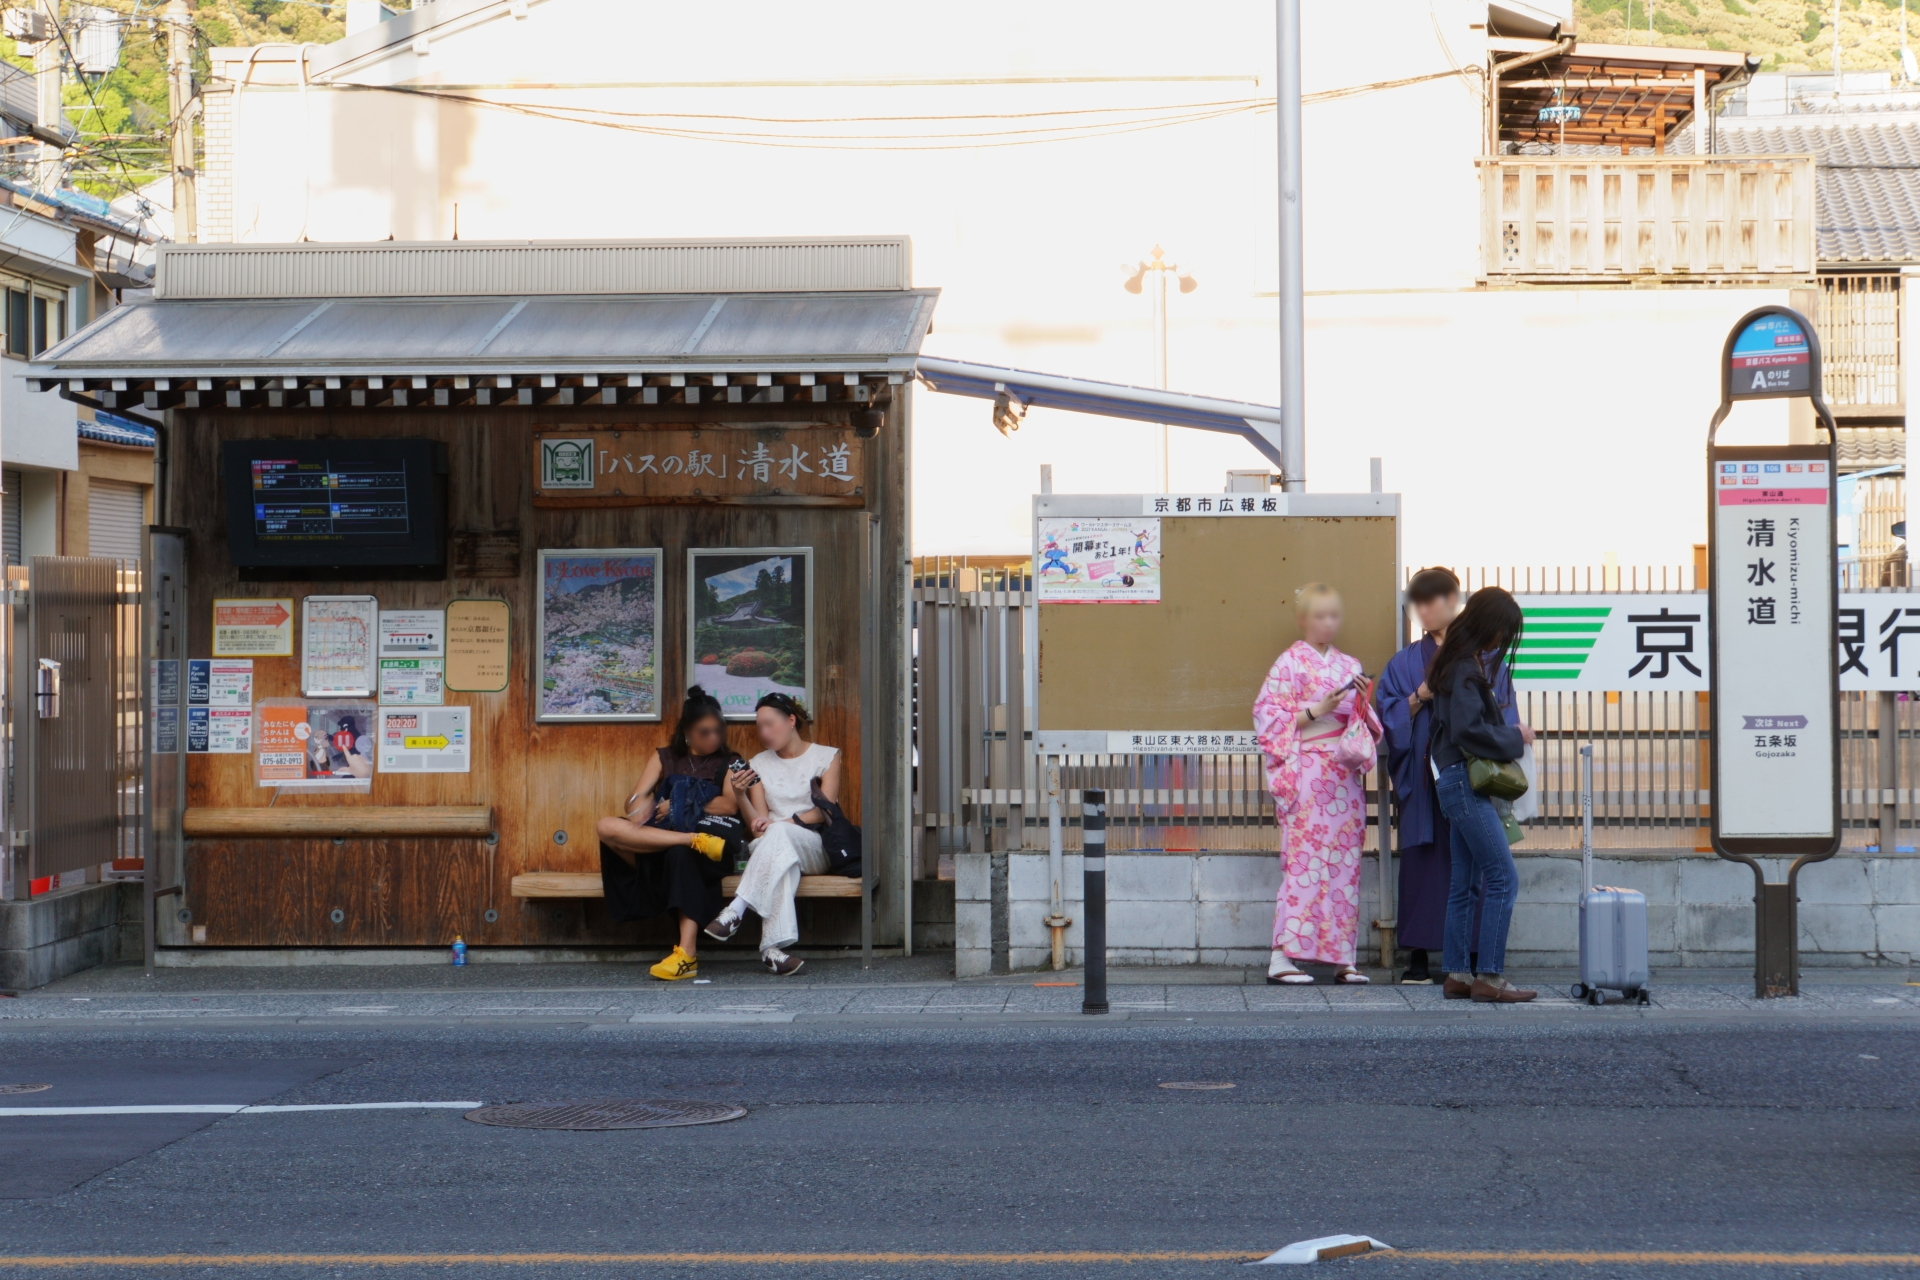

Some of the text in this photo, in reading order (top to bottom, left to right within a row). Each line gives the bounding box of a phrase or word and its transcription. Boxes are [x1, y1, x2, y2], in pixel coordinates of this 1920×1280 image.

[1768, 321, 1790, 330] 市バス
[1746, 357, 1771, 366] 京都バス
[1751, 371, 1767, 389] A
[1768, 370, 1790, 379] のりば
[600, 441, 855, 484] 「バスの駅」 清水道
[1154, 497, 1278, 512] 京都市広報板
[1072, 540, 1109, 554] 開幕まで
[560, 562, 600, 578] Love
[604, 560, 651, 581] Kyoto
[1747, 518, 1776, 625] 清水道
[1787, 518, 1800, 624] Kiyomizu-michi
[713, 690, 751, 706] Love
[387, 719, 416, 727] 202 207
[1754, 718, 1773, 727] 次は
[1132, 735, 1259, 746] 東山区東大路松原上る
[1754, 734, 1797, 748] 五条坂
